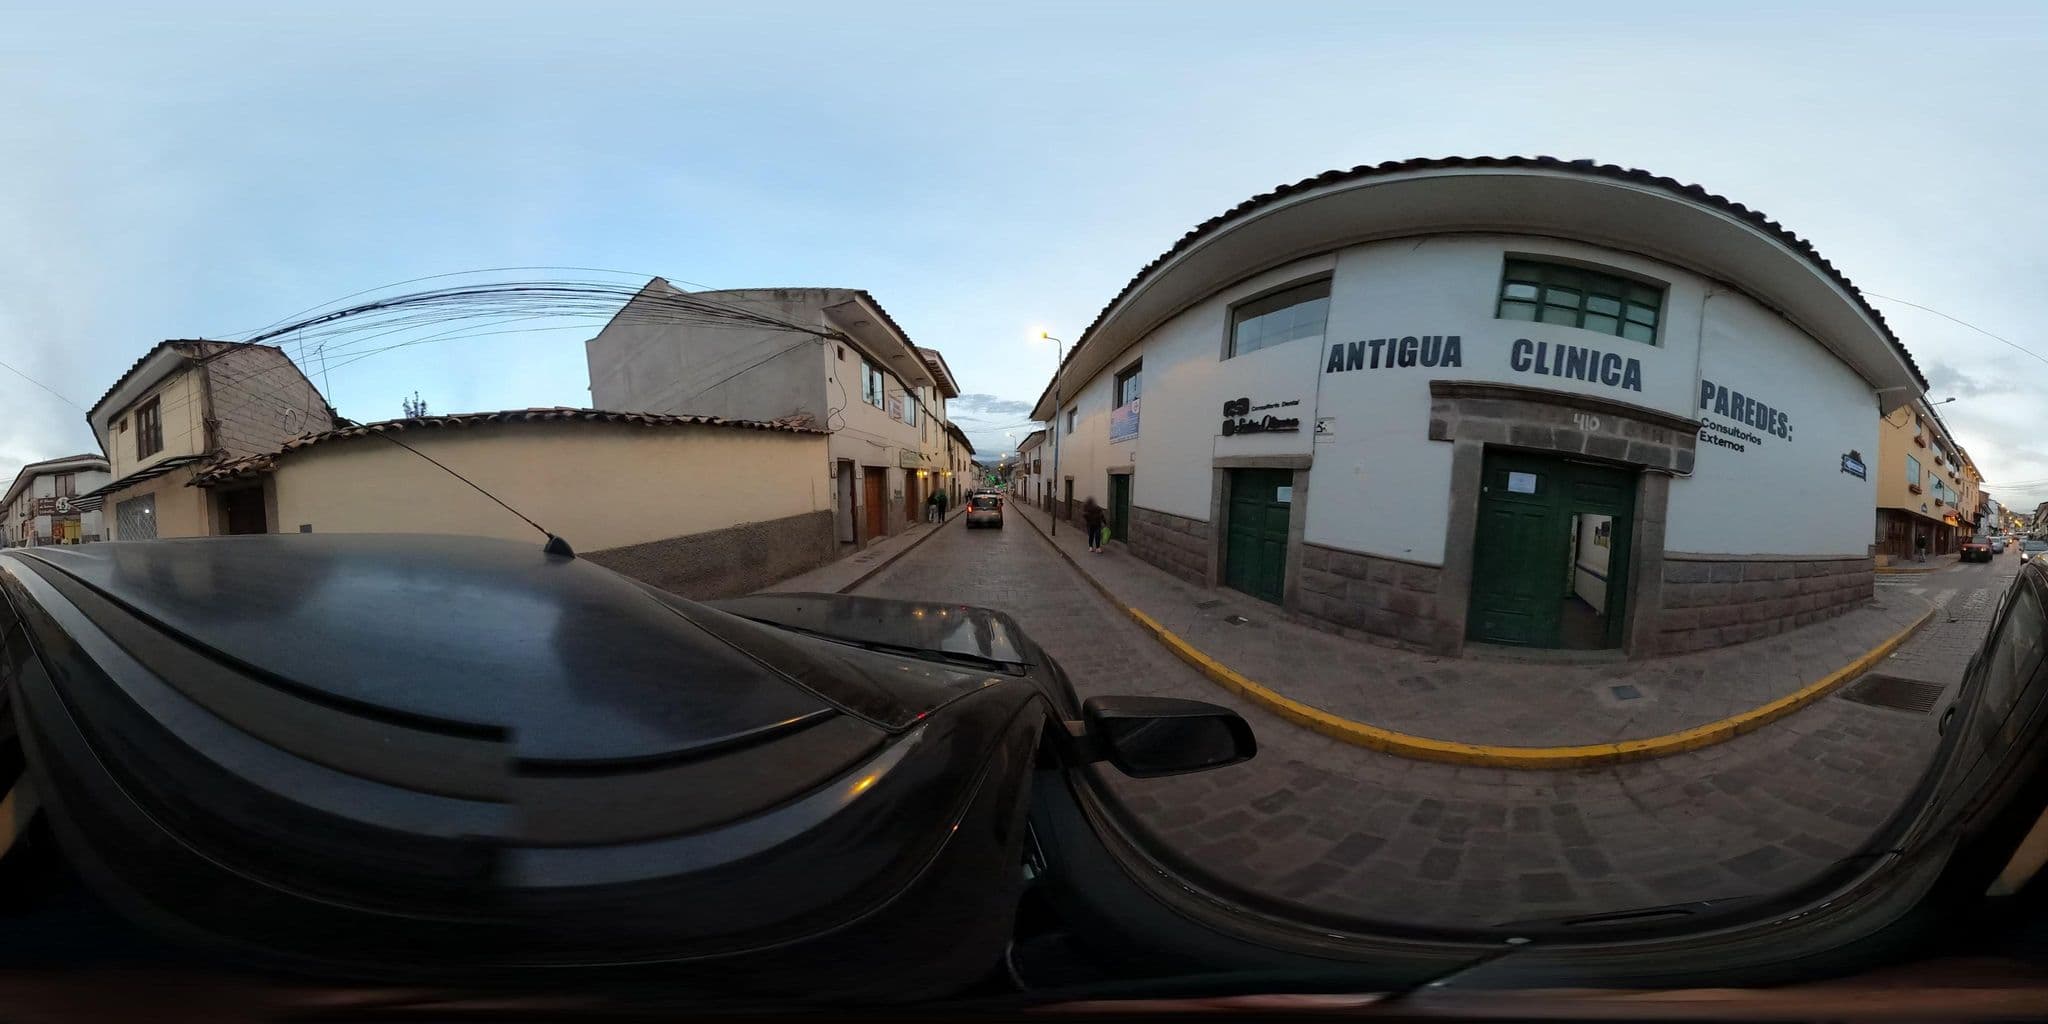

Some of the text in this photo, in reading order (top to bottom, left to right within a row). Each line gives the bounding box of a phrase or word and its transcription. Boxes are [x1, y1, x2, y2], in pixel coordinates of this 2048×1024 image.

[1326, 335, 1793, 442] ANTIGUA CLINICA PAREDES:
[1573, 413, 1600, 431] 410
[1701, 417, 1762, 445] Consultorios
[1700, 430, 1745, 453] Externos
